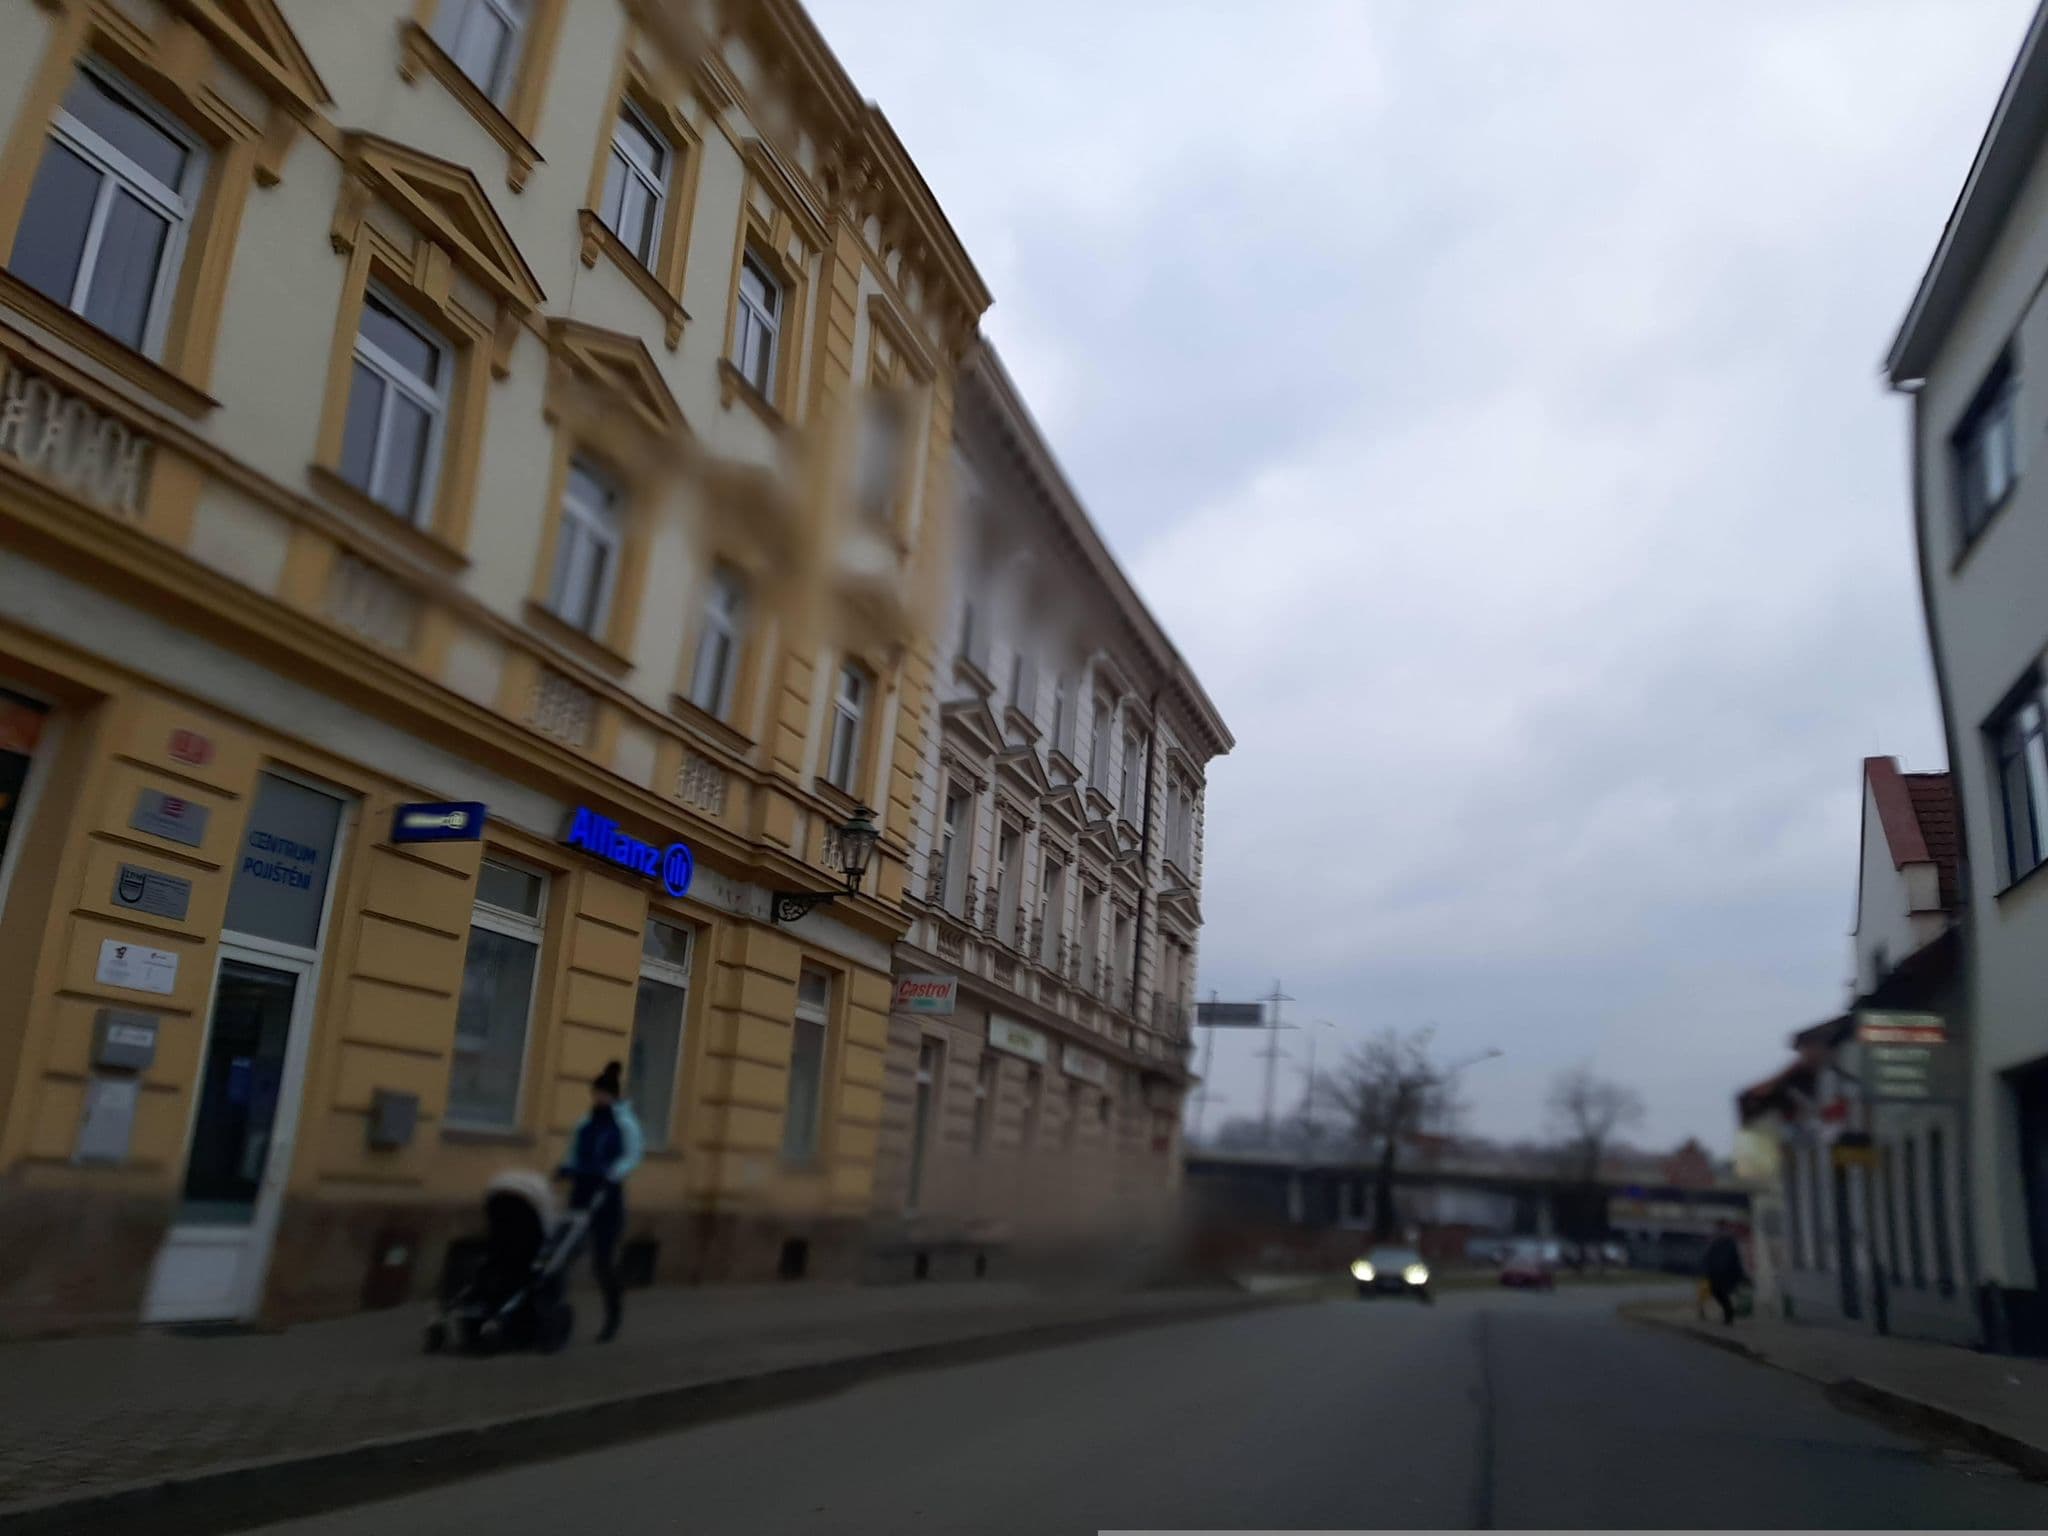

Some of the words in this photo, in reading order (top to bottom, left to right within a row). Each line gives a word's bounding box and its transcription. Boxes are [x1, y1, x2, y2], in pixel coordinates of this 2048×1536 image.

[249, 831, 317, 862] CENTRUM
[568, 807, 661, 877] Allianz
[899, 980, 951, 998] Castrol
